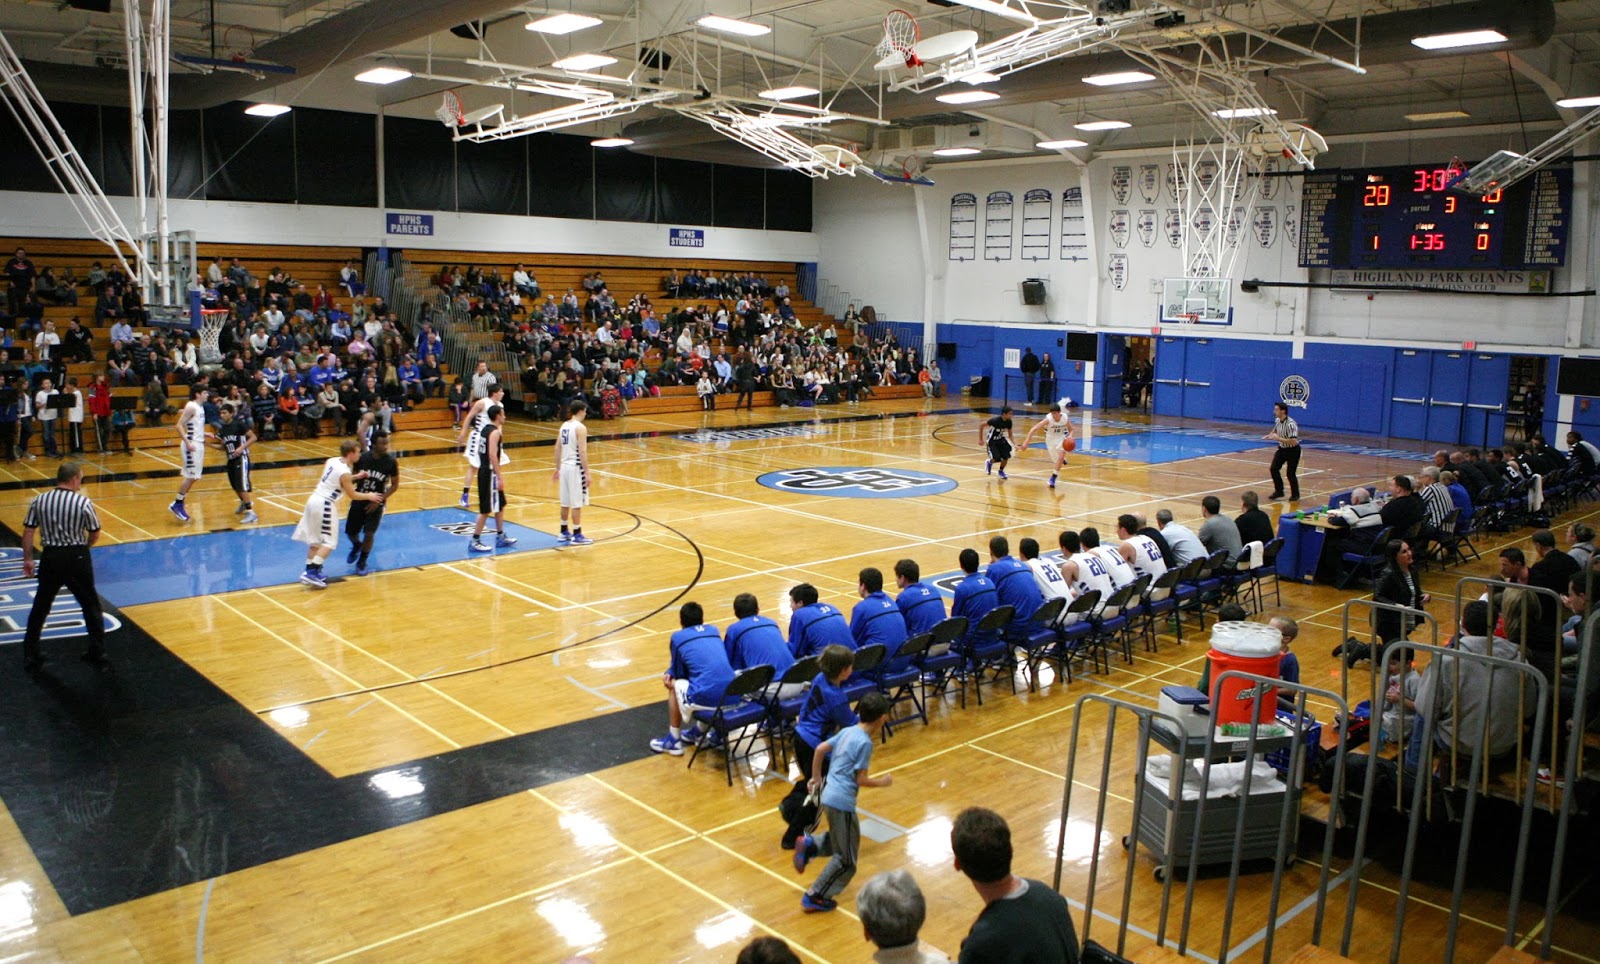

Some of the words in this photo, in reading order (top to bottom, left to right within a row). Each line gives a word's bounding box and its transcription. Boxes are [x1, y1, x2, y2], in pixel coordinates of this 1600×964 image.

[1364, 185, 1390, 207] 28
[1410, 204, 1430, 213] period
[1444, 196, 1456, 213] 3
[399, 215, 421, 225] HPHS
[391, 223, 430, 235] PARENTS
[679, 230, 696, 239] HPHS
[671, 237, 703, 247] STUDENTS
[1373, 234, 1379, 250] 1
[1410, 234, 1445, 250] 1-35
[1477, 233, 1489, 250] 0
[1353, 271, 1424, 283] HIGHLAND
[1429, 272, 1464, 283] PARK
[1469, 272, 1524, 283] GIANTS
[1142, 541, 1162, 562] 23
[1041, 564, 1062, 583] 21
[1084, 556, 1107, 577] 20
